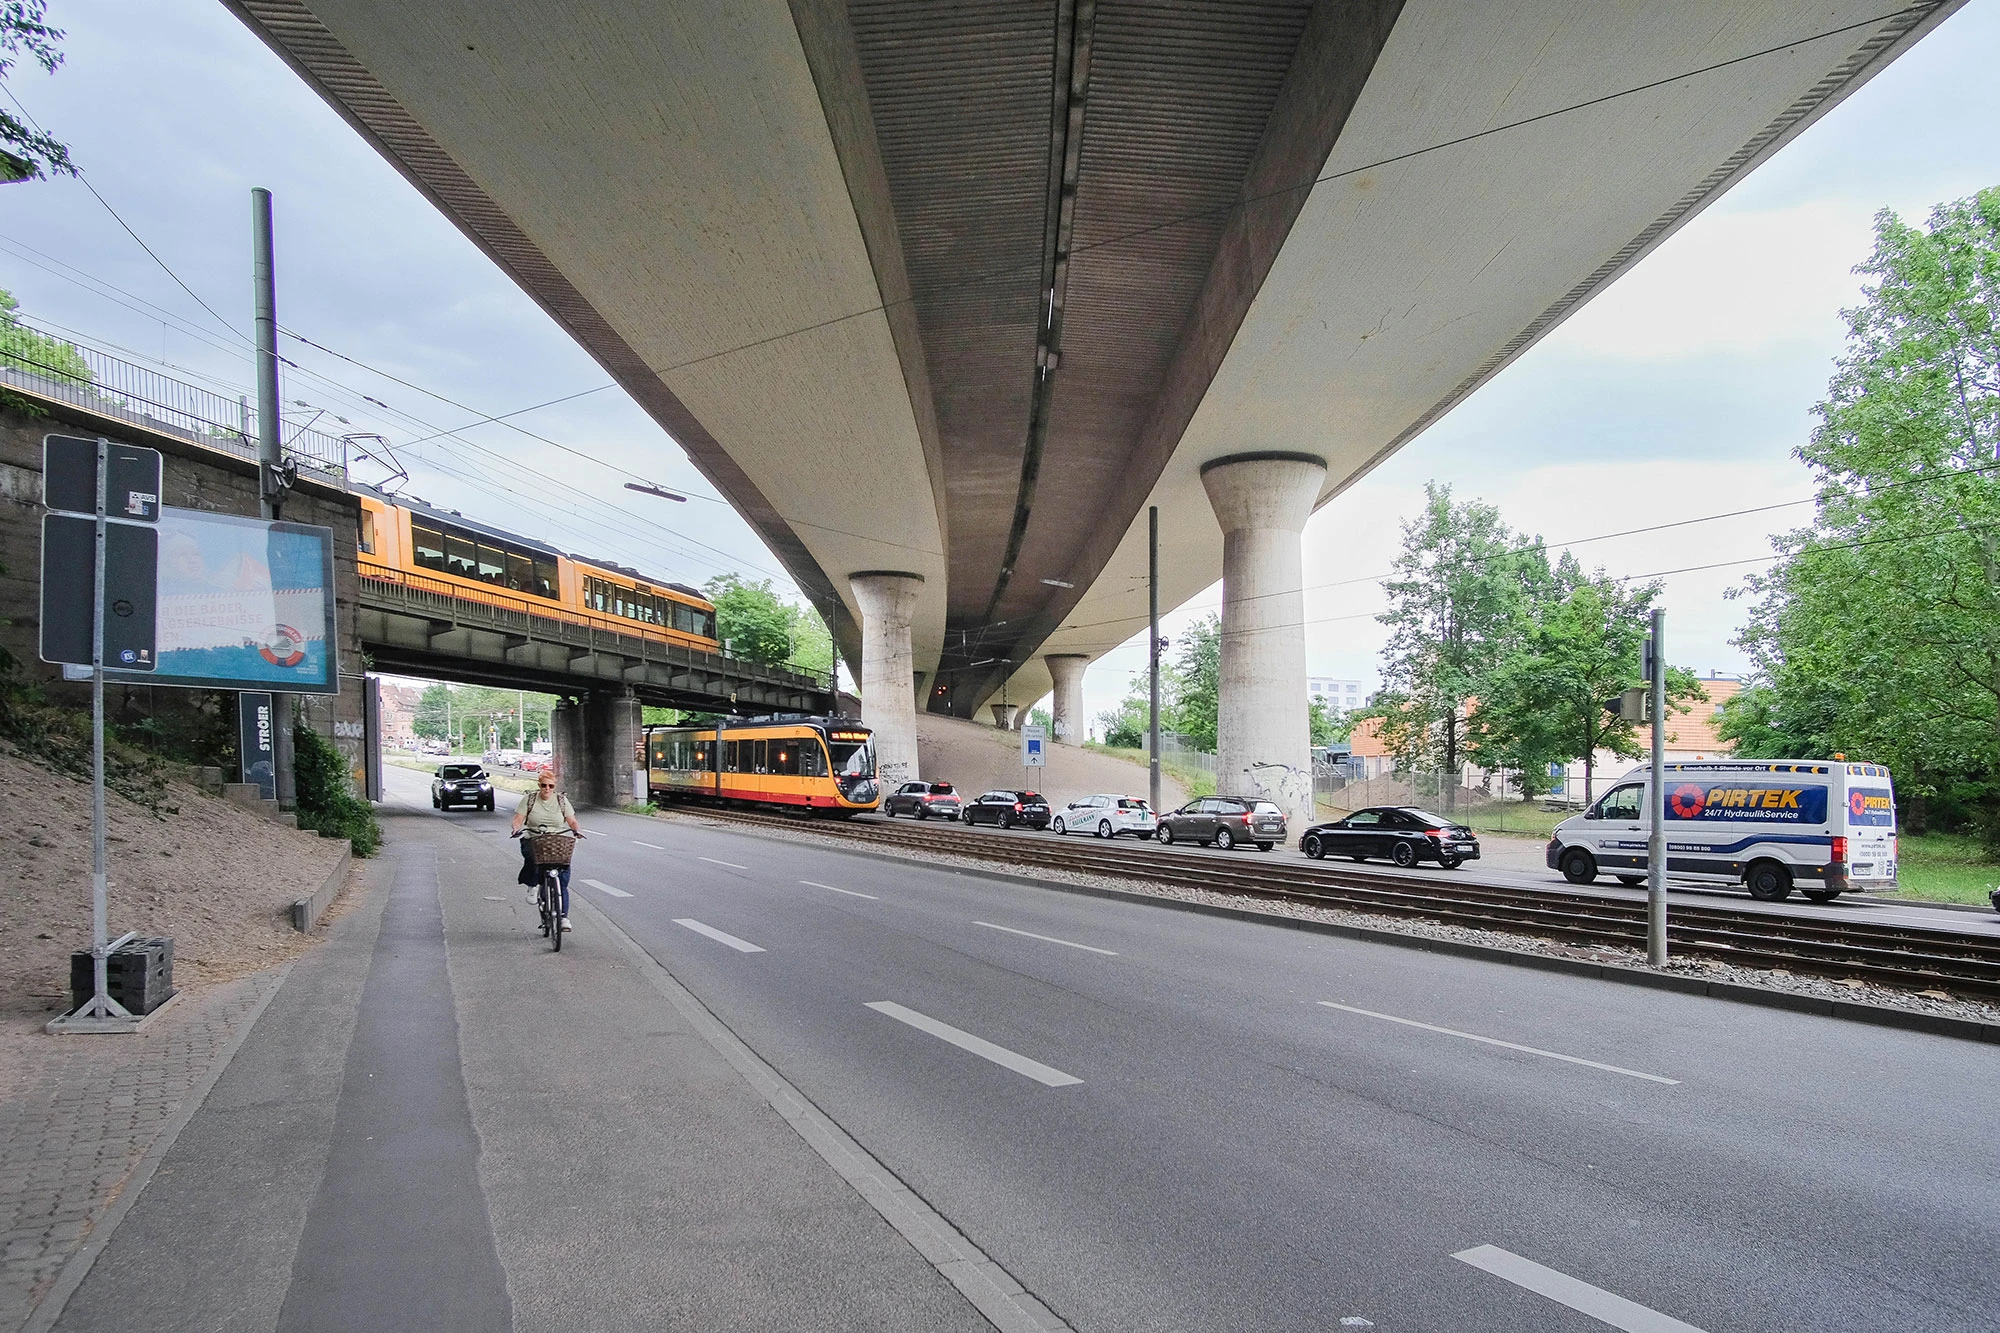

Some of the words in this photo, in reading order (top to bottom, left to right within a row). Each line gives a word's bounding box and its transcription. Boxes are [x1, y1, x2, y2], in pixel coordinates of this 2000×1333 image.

[175, 605, 197, 616] DIE
[257, 705, 270, 751] STRÖER
[1705, 789, 1803, 809] PIRTEK
[1864, 796, 1890, 809] PIRTEK
[1704, 809, 1722, 817] 24/7
[1723, 809, 1799, 819] HydraulikService
